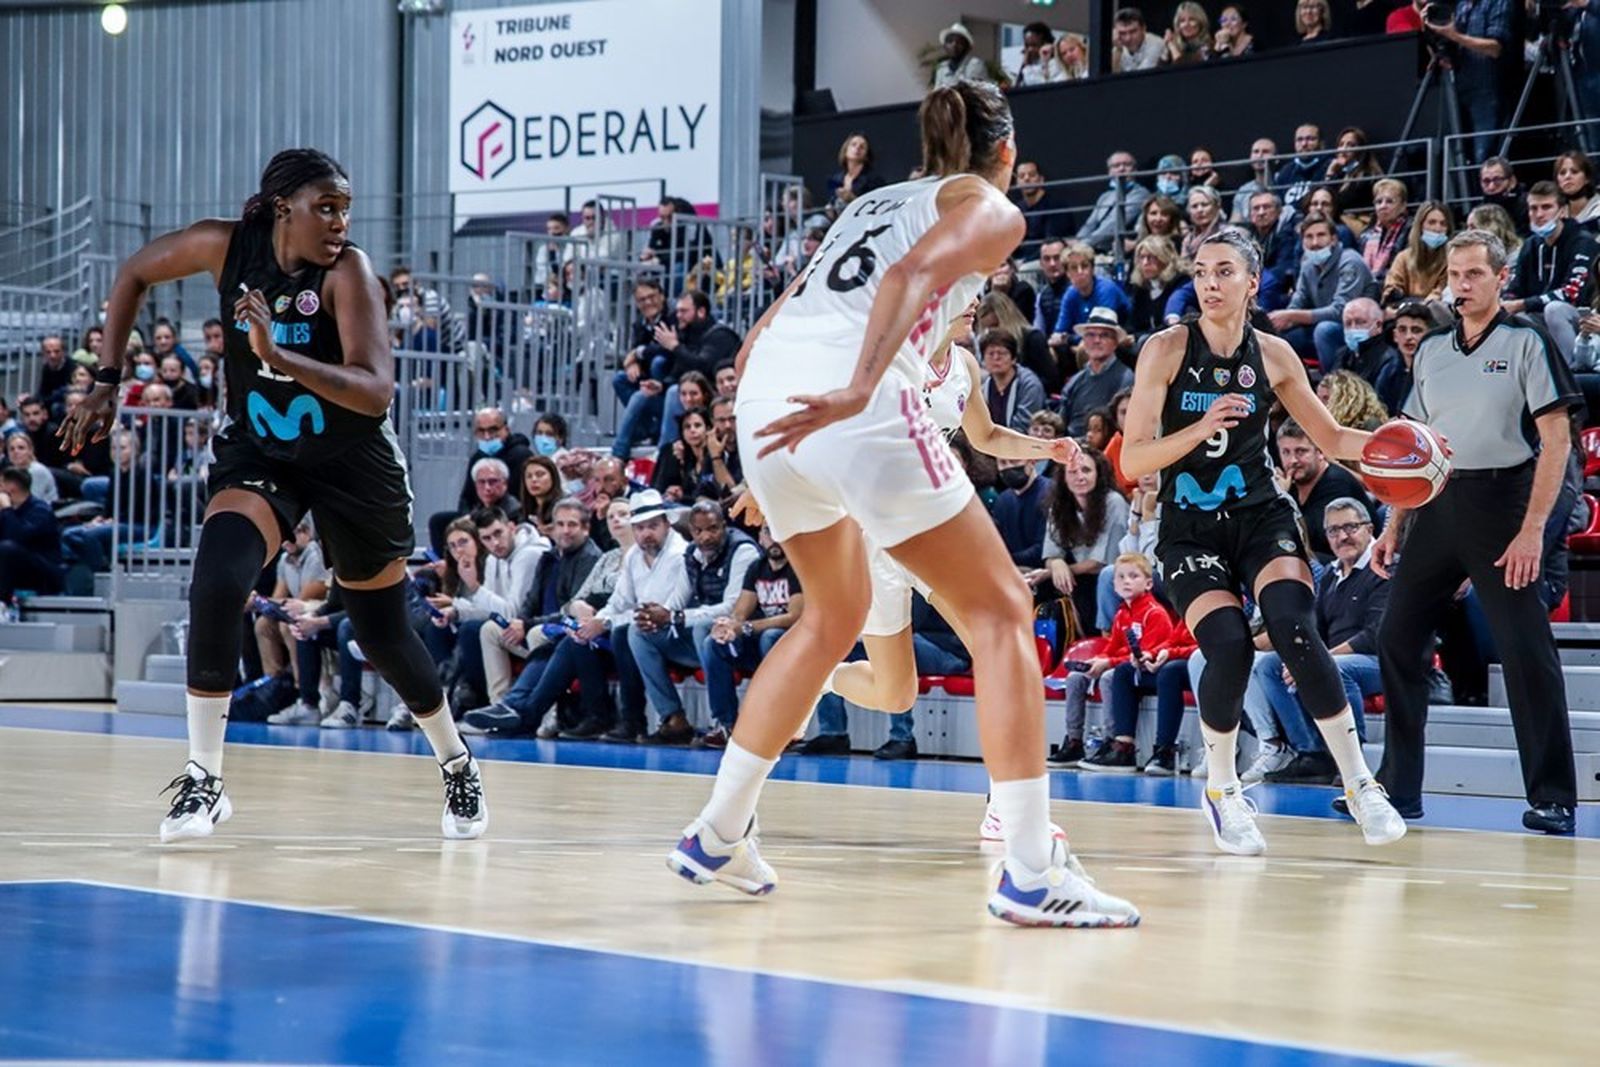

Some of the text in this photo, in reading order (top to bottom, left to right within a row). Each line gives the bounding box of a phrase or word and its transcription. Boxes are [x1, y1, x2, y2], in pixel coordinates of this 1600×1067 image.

[496, 14, 572, 36] TRIBUNE
[494, 40, 608, 63] NORD OUEST
[1205, 428, 1229, 458] 9
